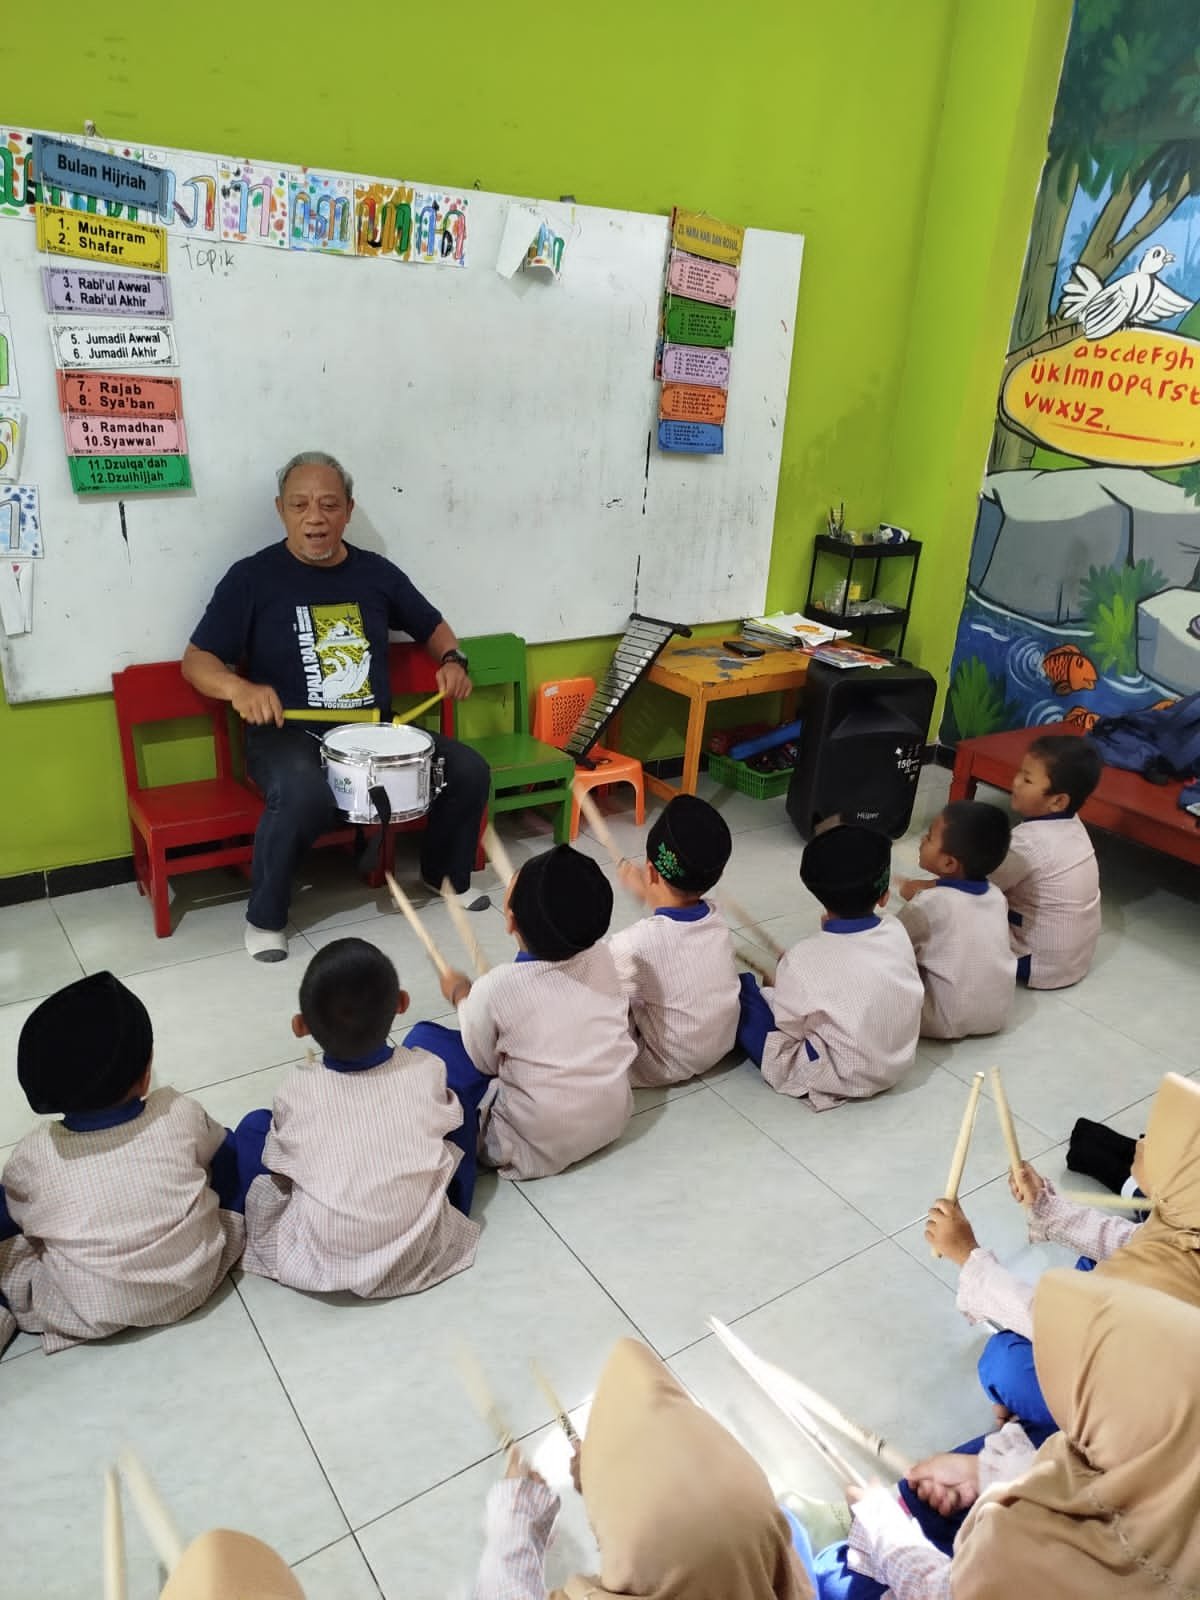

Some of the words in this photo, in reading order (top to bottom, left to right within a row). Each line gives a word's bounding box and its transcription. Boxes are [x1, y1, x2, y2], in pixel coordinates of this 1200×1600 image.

[57, 154, 98, 179] Bulan
[102, 165, 147, 191] Hijriah
[58, 217, 70, 231] 1.
[78, 220, 146, 245] Muharram
[58, 233, 71, 247] 2.
[79, 237, 125, 256] Shafar
[180, 243, 235, 274] Topik
[63, 277, 73, 290] 3.
[78, 279, 115, 293] Rabi'ul
[118, 281, 151, 294] Awwal
[65, 291, 75, 304] 4.
[81, 292, 118, 306] Rabi'ul
[120, 294, 147, 308] Akhir
[71, 333, 81, 346] 5.
[86, 333, 127, 346] Jumadil
[129, 332, 161, 344] Awwal
[73, 348, 83, 360] 6.
[89, 347, 129, 360] Jumadil
[131, 346, 158, 358] Akhir
[78, 380, 91, 393] 7.
[100, 381, 142, 397] Rajab
[79, 395, 92, 407] 8.
[100, 395, 155, 411] Sya'ban
[82, 421, 94, 433] 9.
[100, 421, 165, 434] Ramadhan
